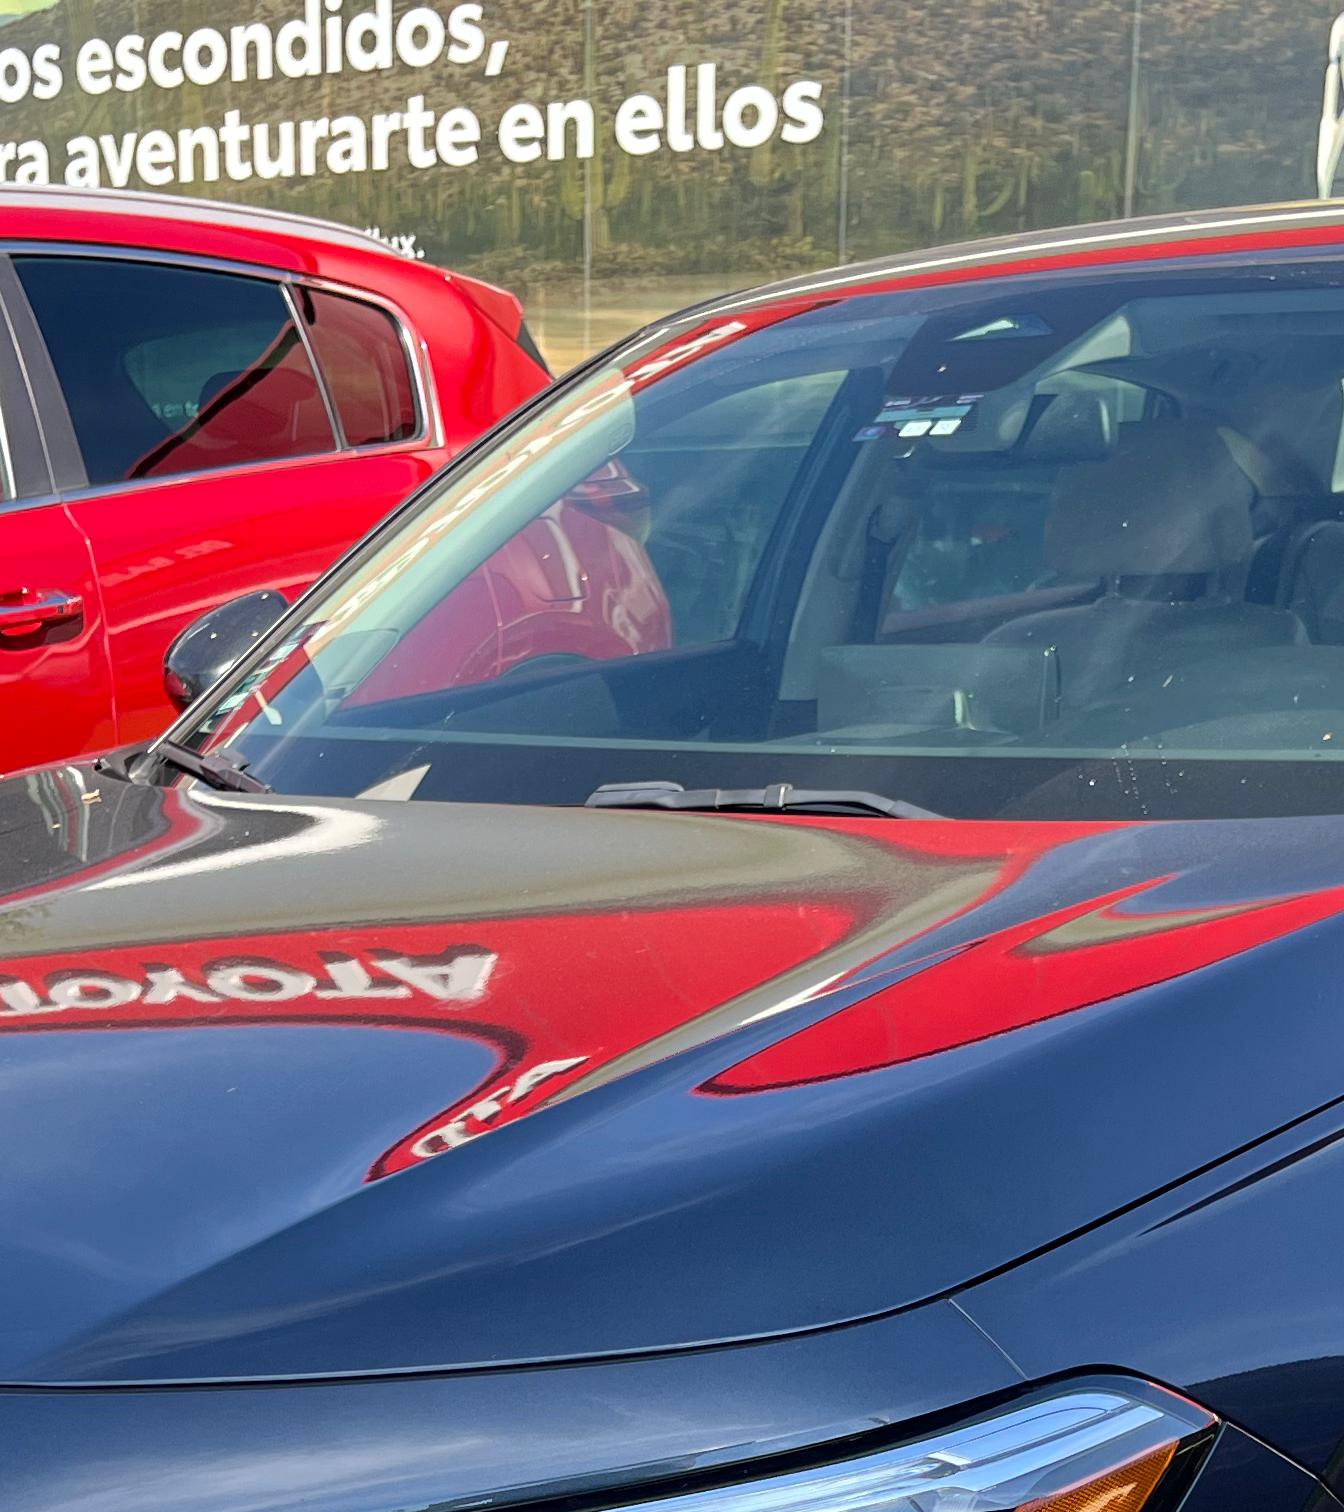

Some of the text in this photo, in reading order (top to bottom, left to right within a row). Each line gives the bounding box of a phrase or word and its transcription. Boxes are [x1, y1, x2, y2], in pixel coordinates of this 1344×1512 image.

[76, 0, 509, 94] escondidos,
[64, 96, 480, 188] aventurarte
[499, 99, 593, 163] en
[614, 63, 824, 154] ellos
